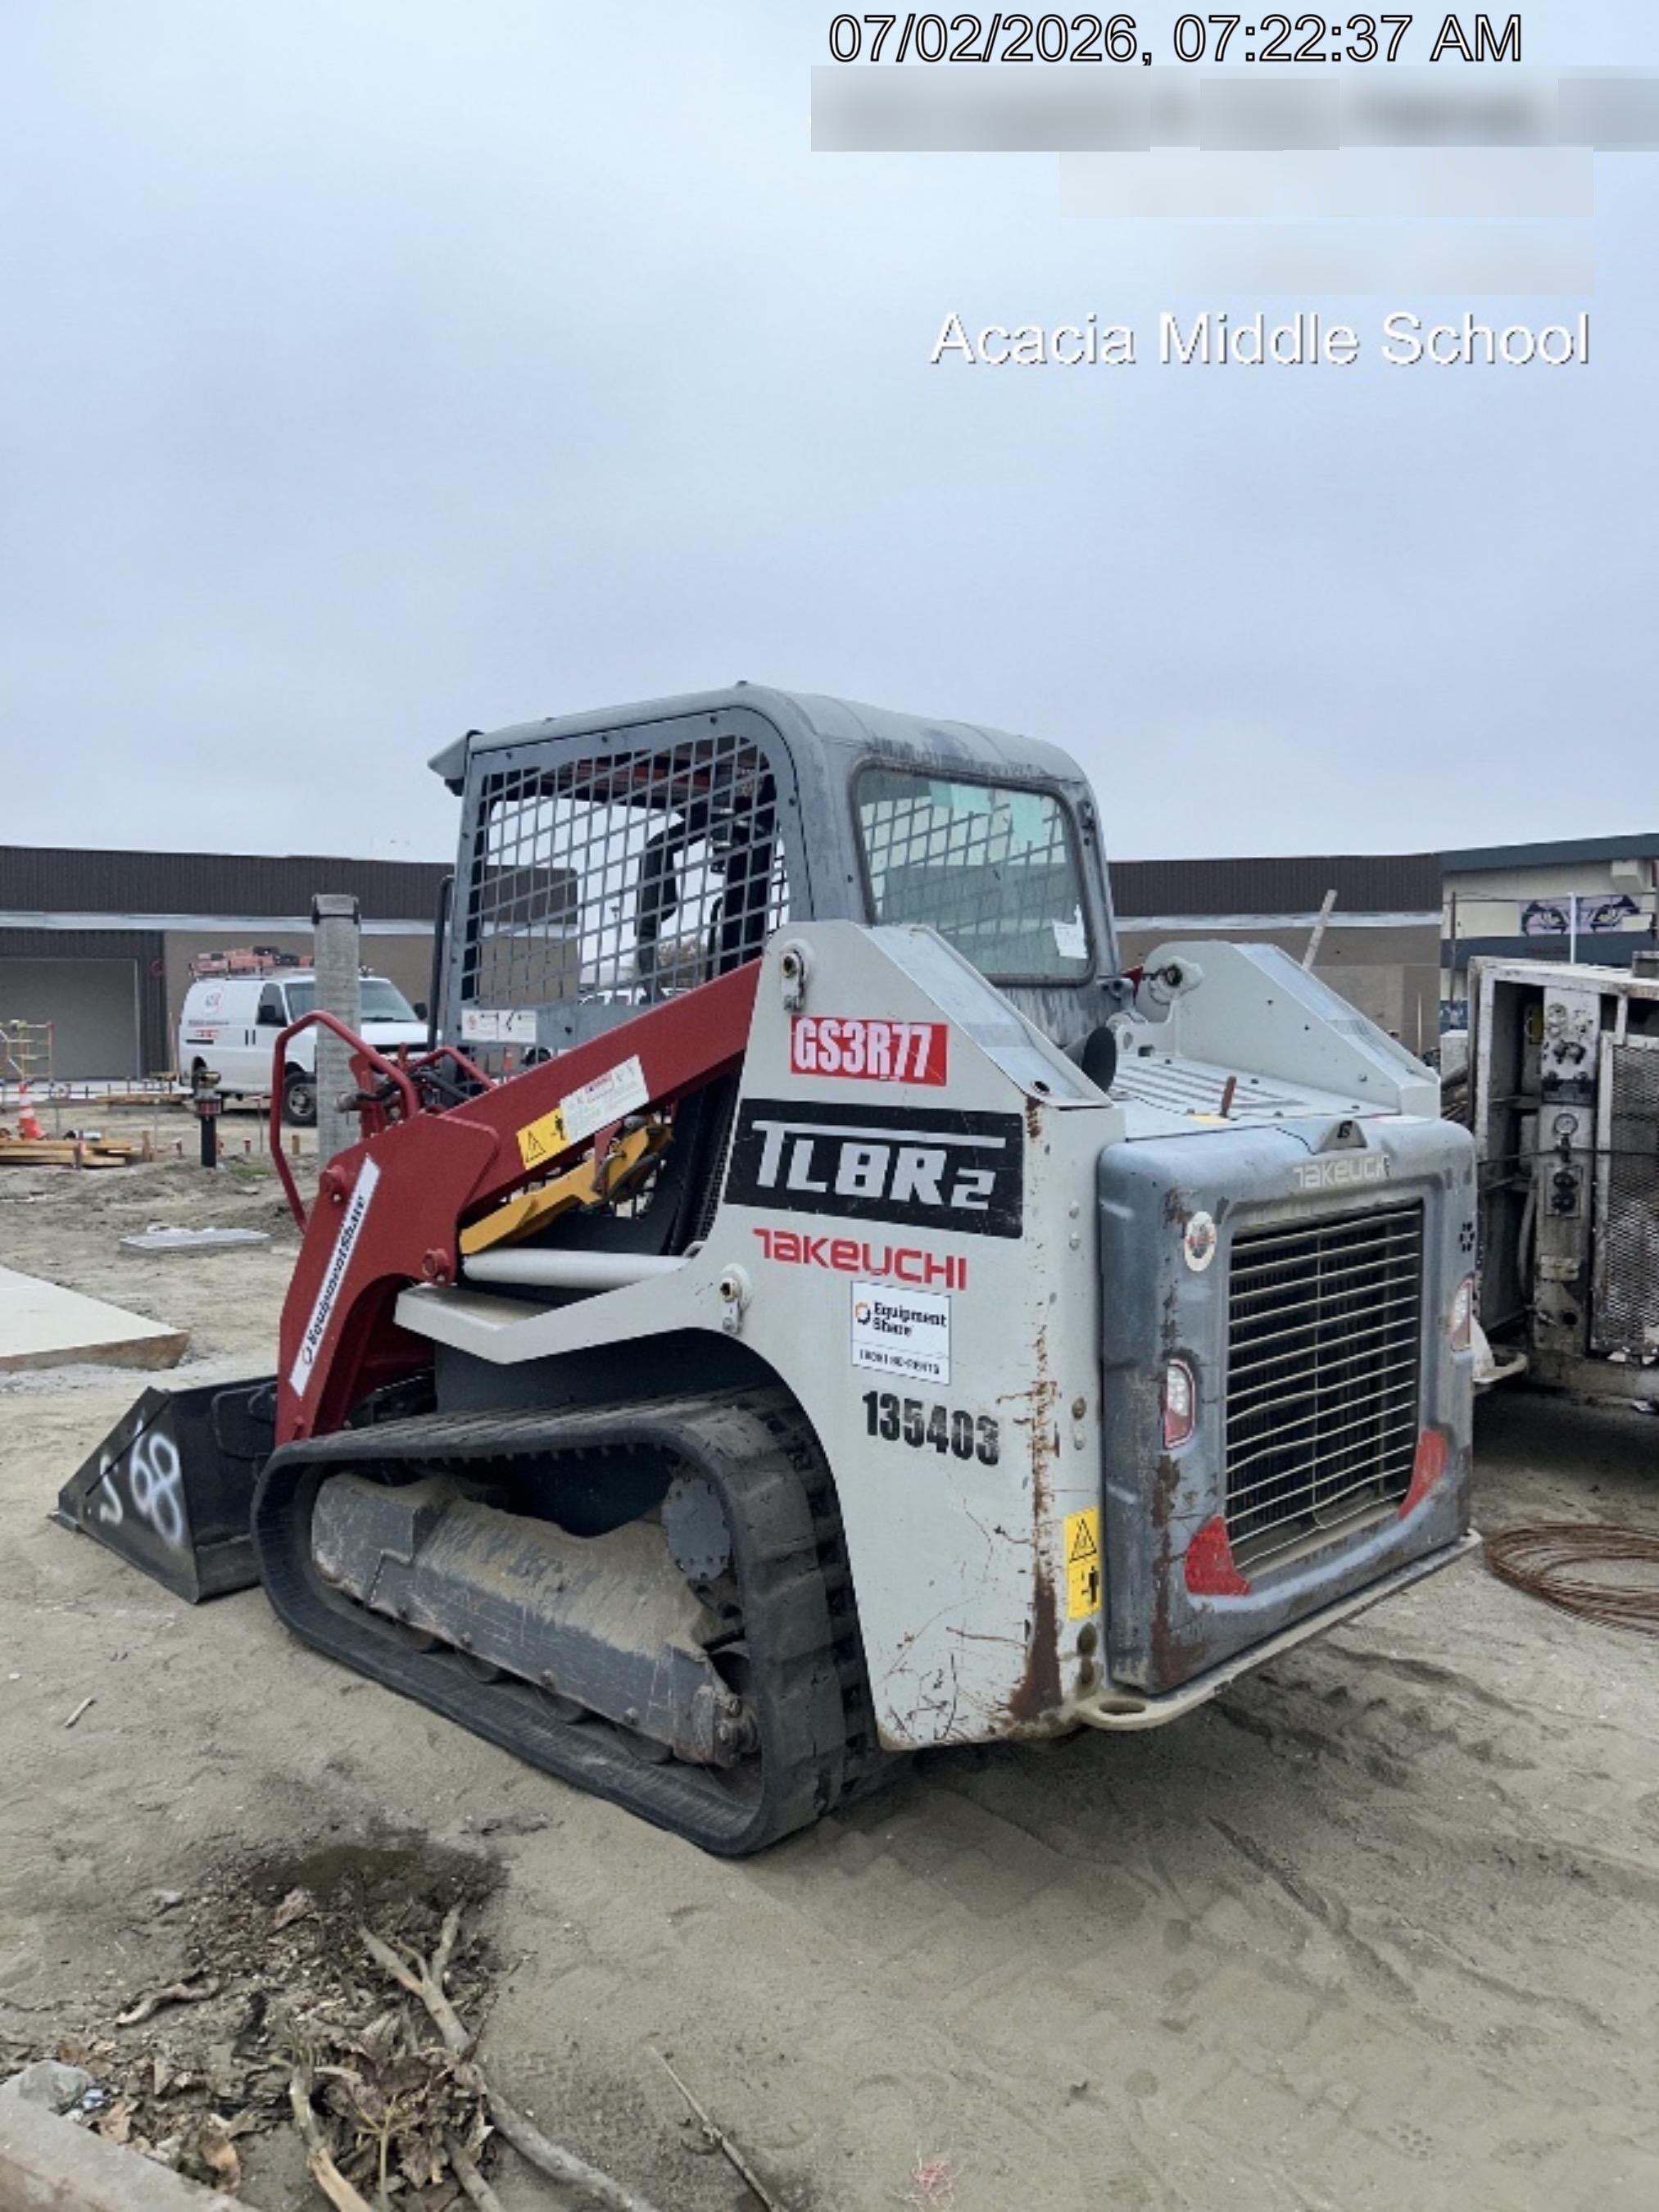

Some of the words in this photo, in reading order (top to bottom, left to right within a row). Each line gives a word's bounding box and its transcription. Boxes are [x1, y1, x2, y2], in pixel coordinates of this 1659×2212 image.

[793, 1018, 933, 1080] GS3R77
[873, 1301, 947, 1327] Equipment
[862, 1390, 999, 1466] 135403
